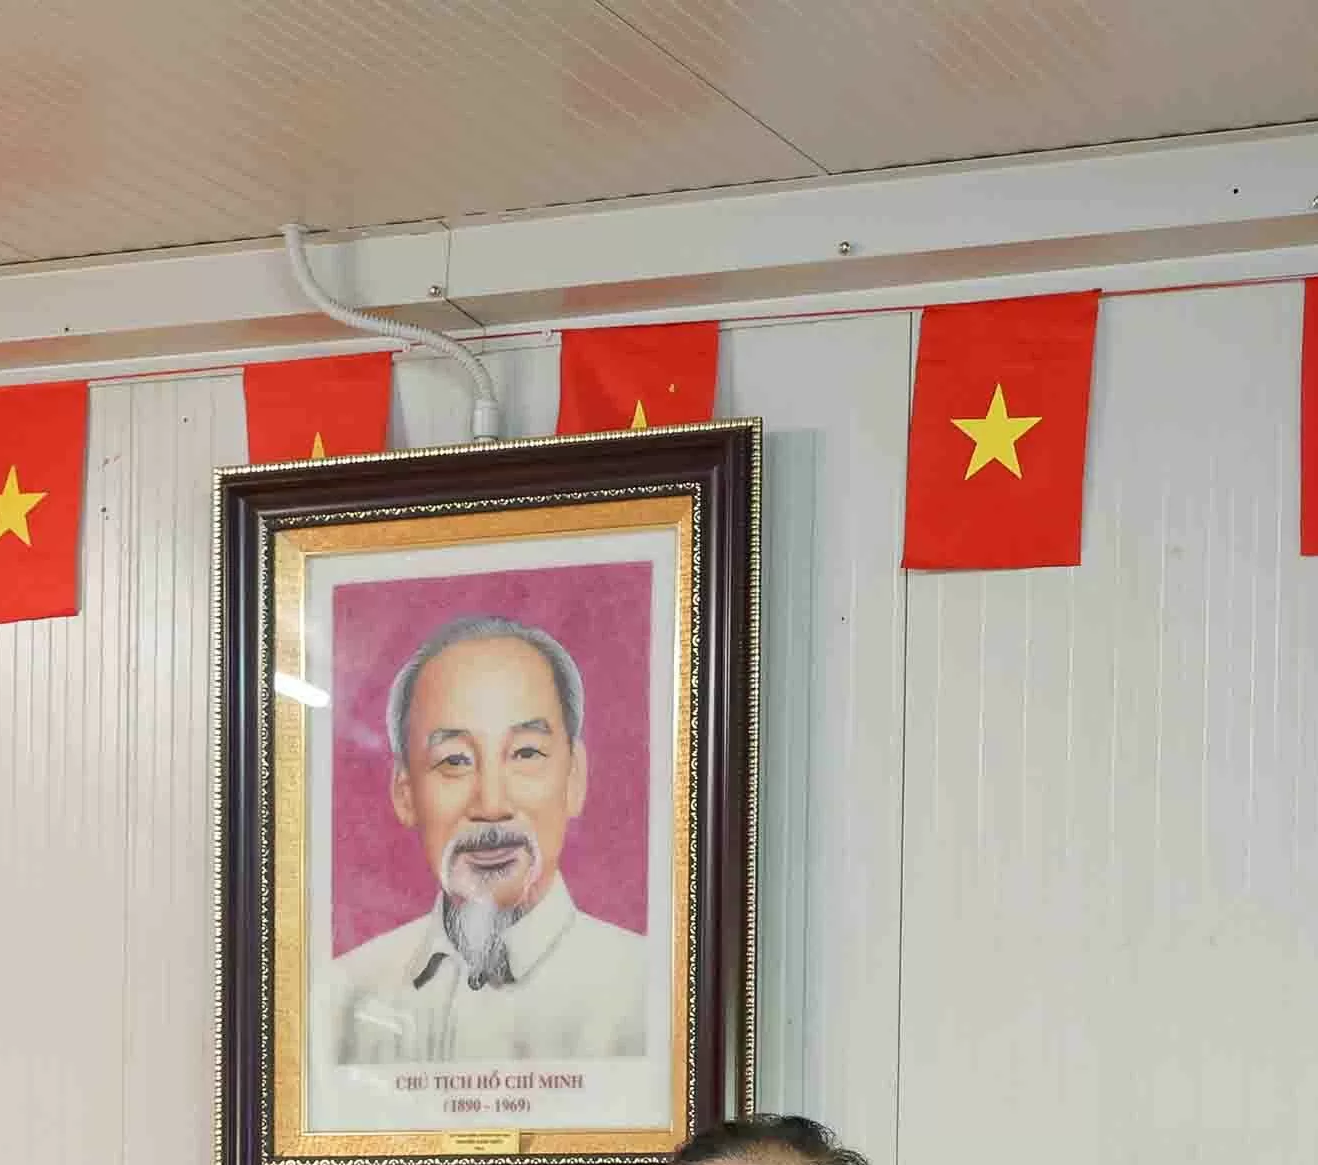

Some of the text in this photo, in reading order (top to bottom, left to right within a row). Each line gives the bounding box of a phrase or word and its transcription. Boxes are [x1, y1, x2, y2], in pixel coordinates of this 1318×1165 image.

[538, 1072, 584, 1090] MINH
[442, 1097, 481, 1113] (1890
[495, 1097, 531, 1113] 1969)
